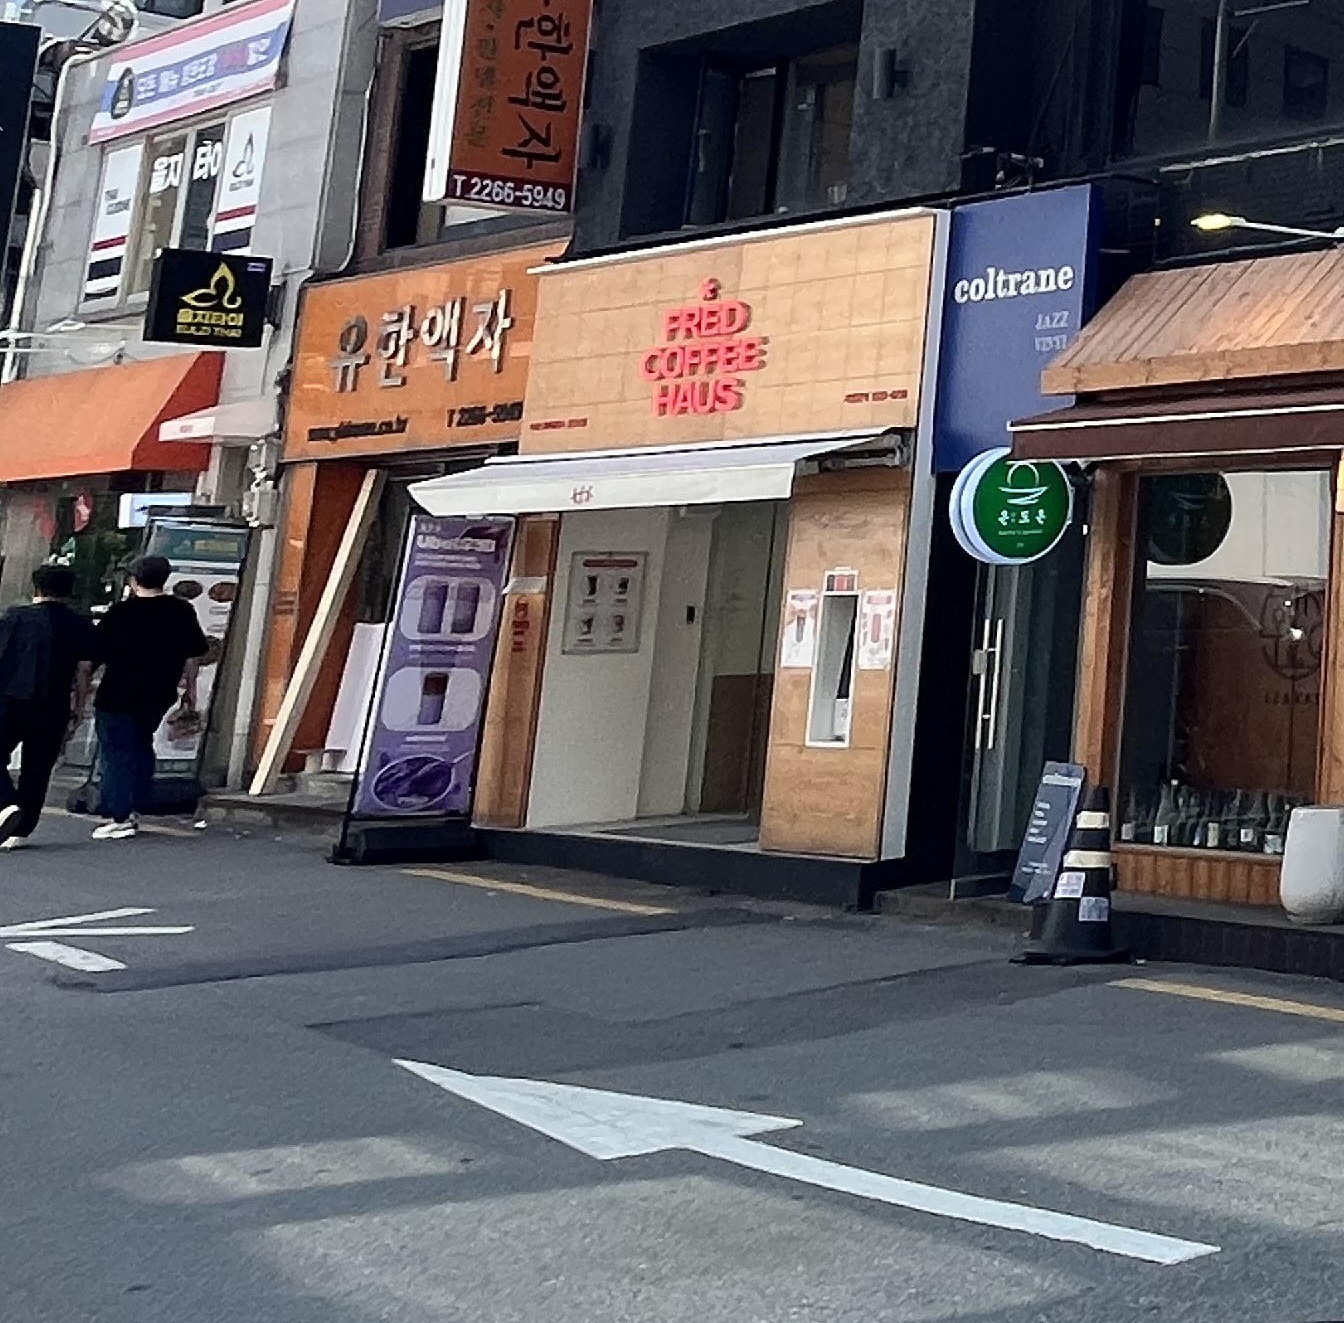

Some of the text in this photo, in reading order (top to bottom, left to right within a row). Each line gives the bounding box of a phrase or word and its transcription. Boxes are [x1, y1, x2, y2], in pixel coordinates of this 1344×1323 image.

[954, 265, 1075, 304] coltrane
[330, 288, 516, 393] 유한액자
[661, 299, 753, 342] FRED
[638, 335, 771, 382] COFFEE
[651, 378, 747, 418] HAUS
